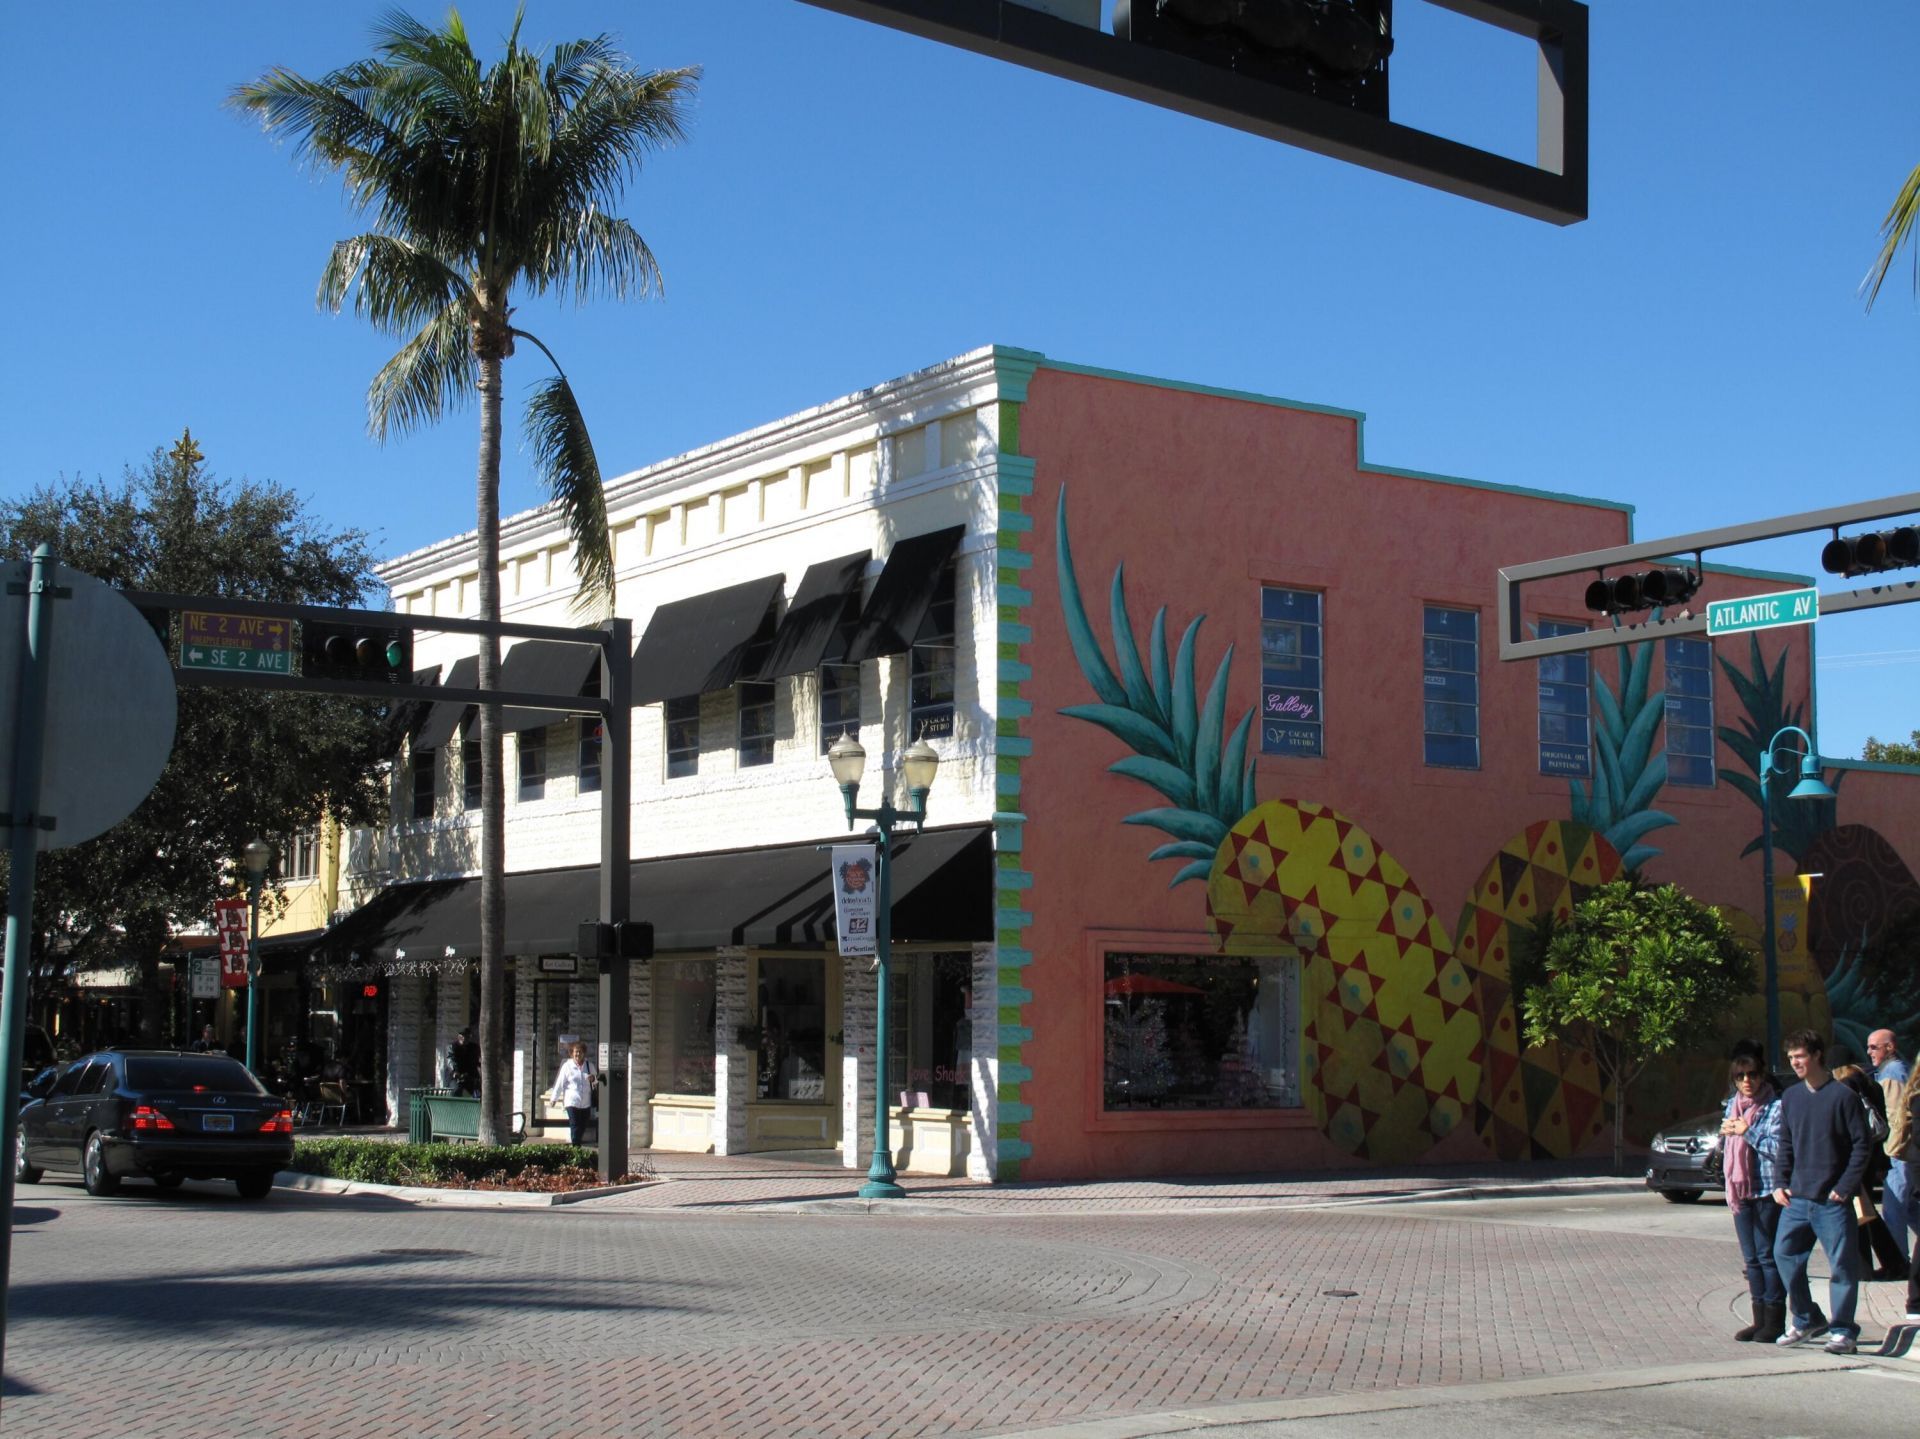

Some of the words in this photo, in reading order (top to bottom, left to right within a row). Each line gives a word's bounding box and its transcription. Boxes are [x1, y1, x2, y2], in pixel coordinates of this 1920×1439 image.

[1714, 601, 1780, 627] ATLANTIC
[1792, 595, 1811, 617] AV
[190, 614, 208, 632] NE
[218, 616, 228, 633] 2
[239, 618, 265, 636] AVE
[211, 649, 228, 665] SE
[238, 651, 247, 666] 2
[257, 653, 283, 670] AVE
[1266, 693, 1315, 719] Gallery
[1542, 751, 1571, 760] ORIGINAL
[1574, 753, 1586, 761] OIL
[1548, 760, 1581, 769] PAINTINGS
[195, 962, 202, 973] 2
[935, 1063, 967, 1083] Shack
